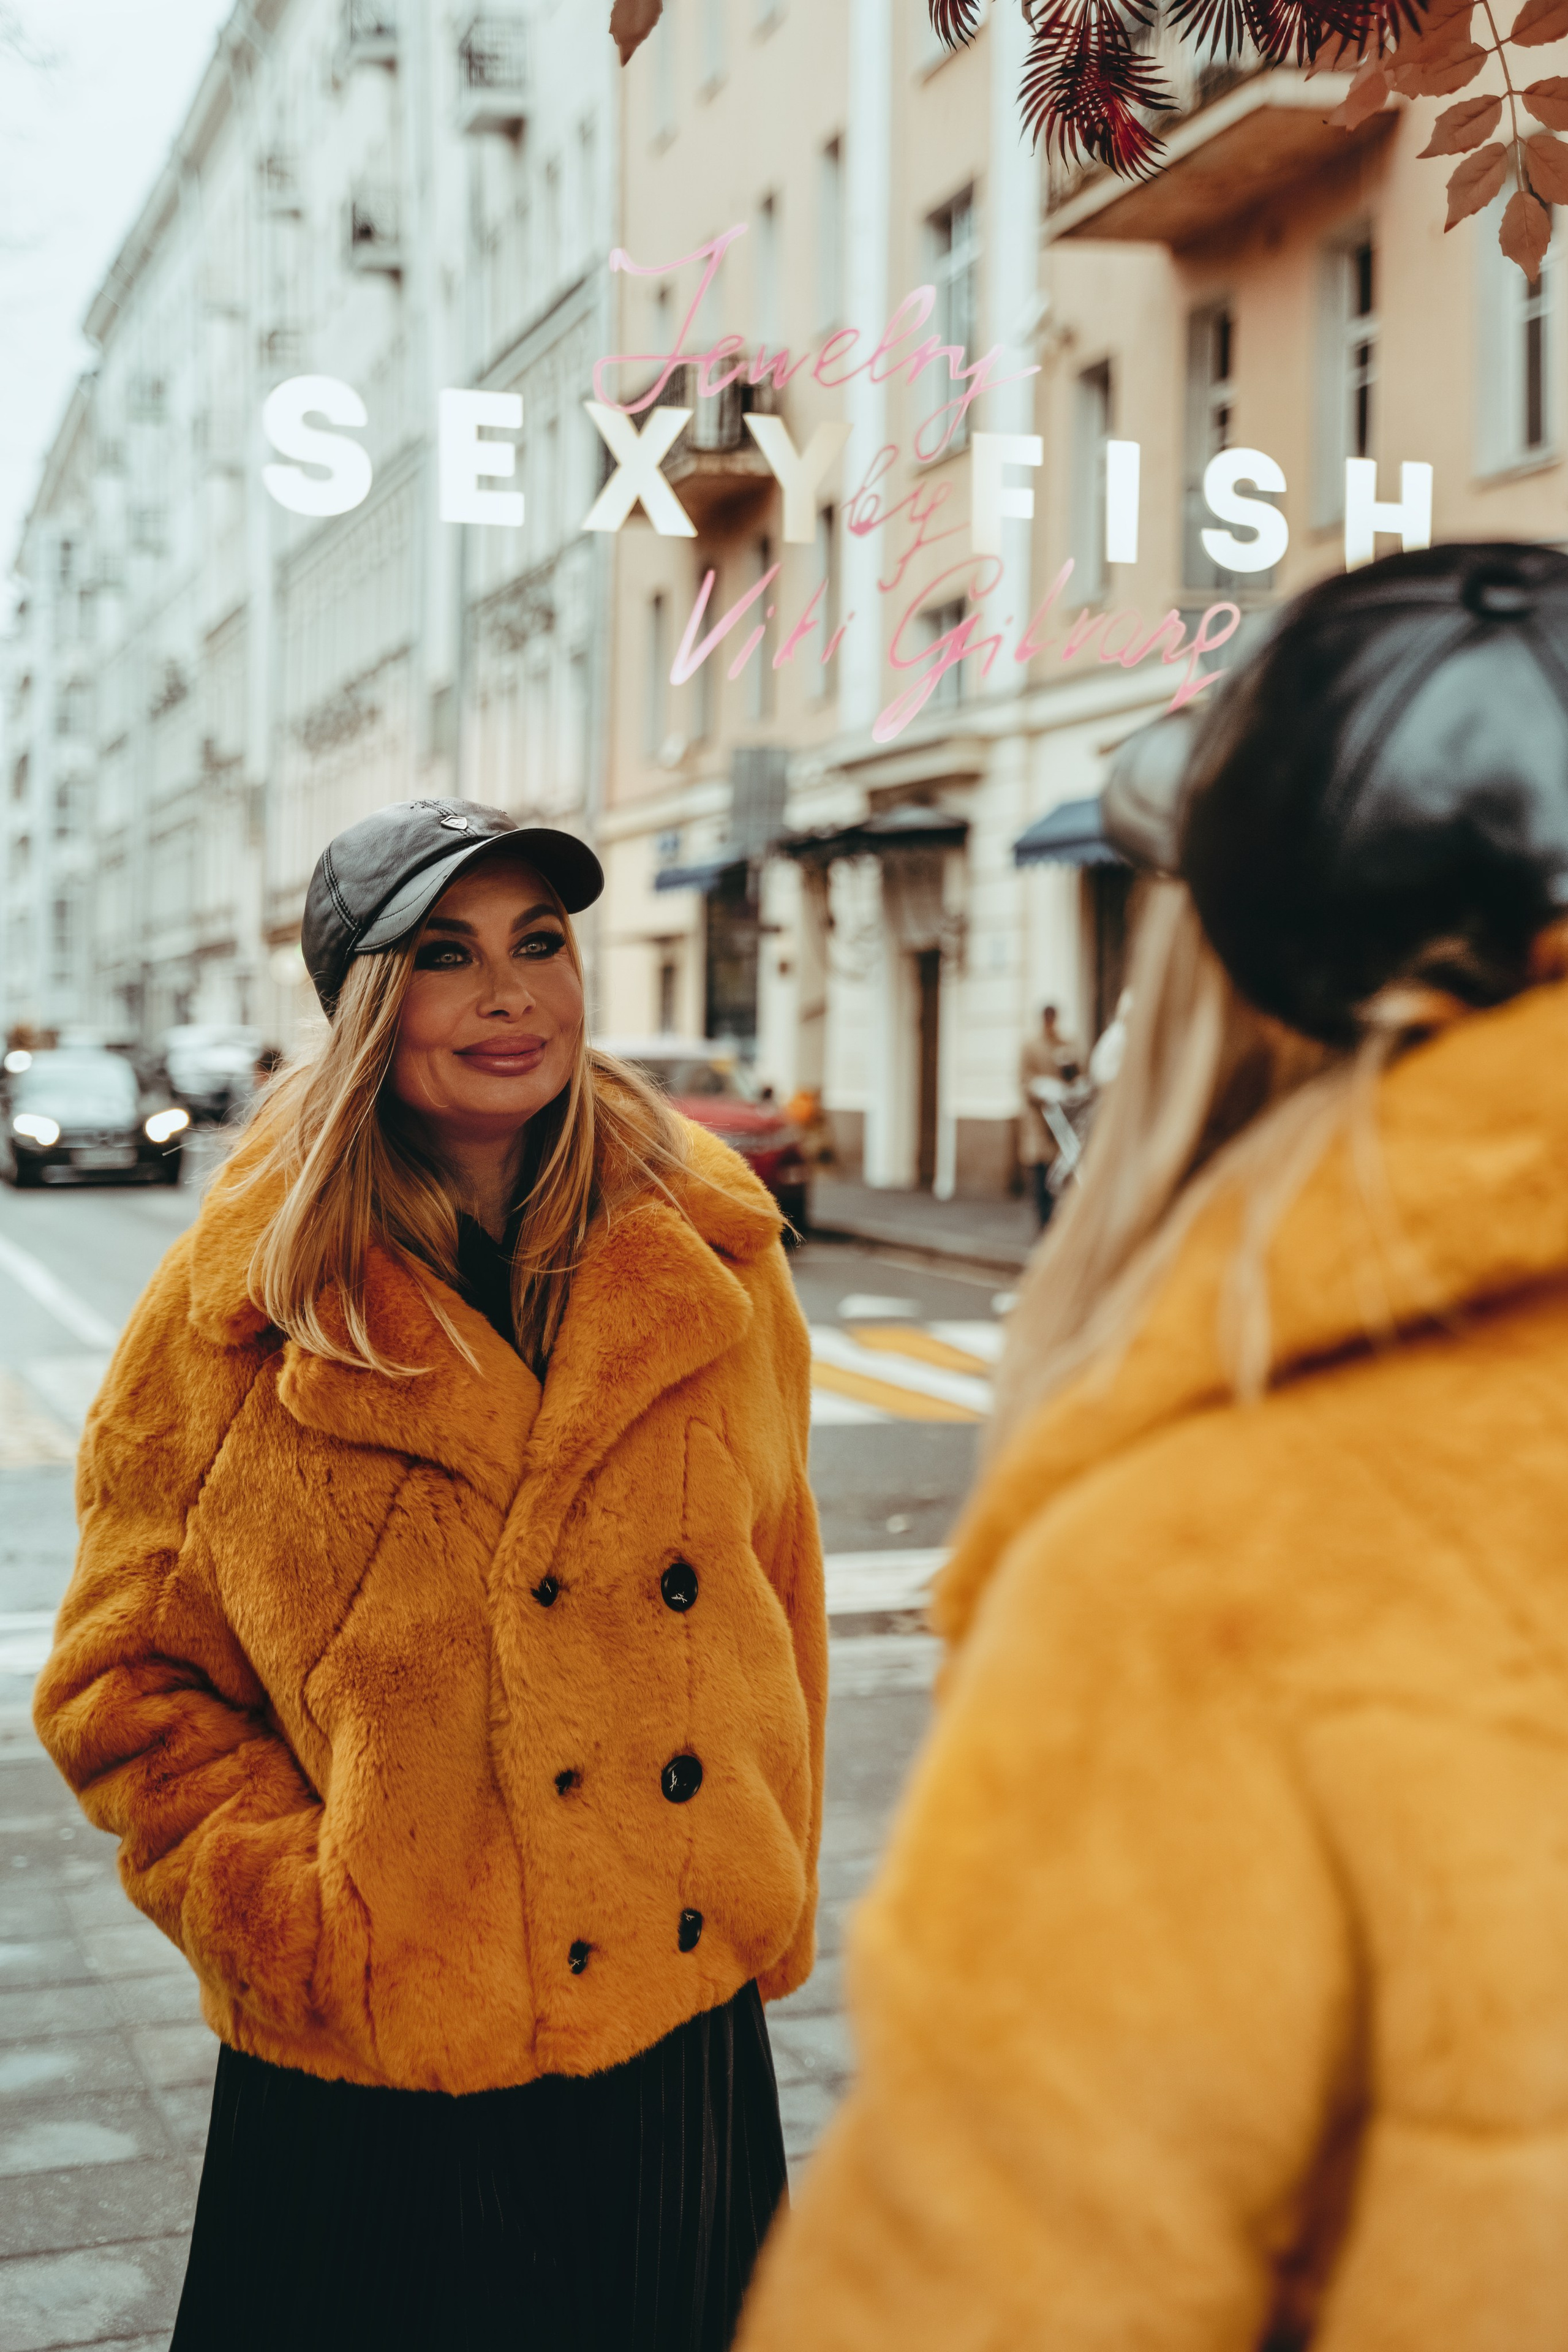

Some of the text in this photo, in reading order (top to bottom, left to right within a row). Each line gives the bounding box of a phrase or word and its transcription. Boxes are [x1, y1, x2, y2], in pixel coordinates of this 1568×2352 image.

[593, 222, 1042, 462] Jewelry
[262, 374, 1433, 573] SEXY FISH
[840, 445, 970, 594] by
[670, 563, 855, 686] Viki
